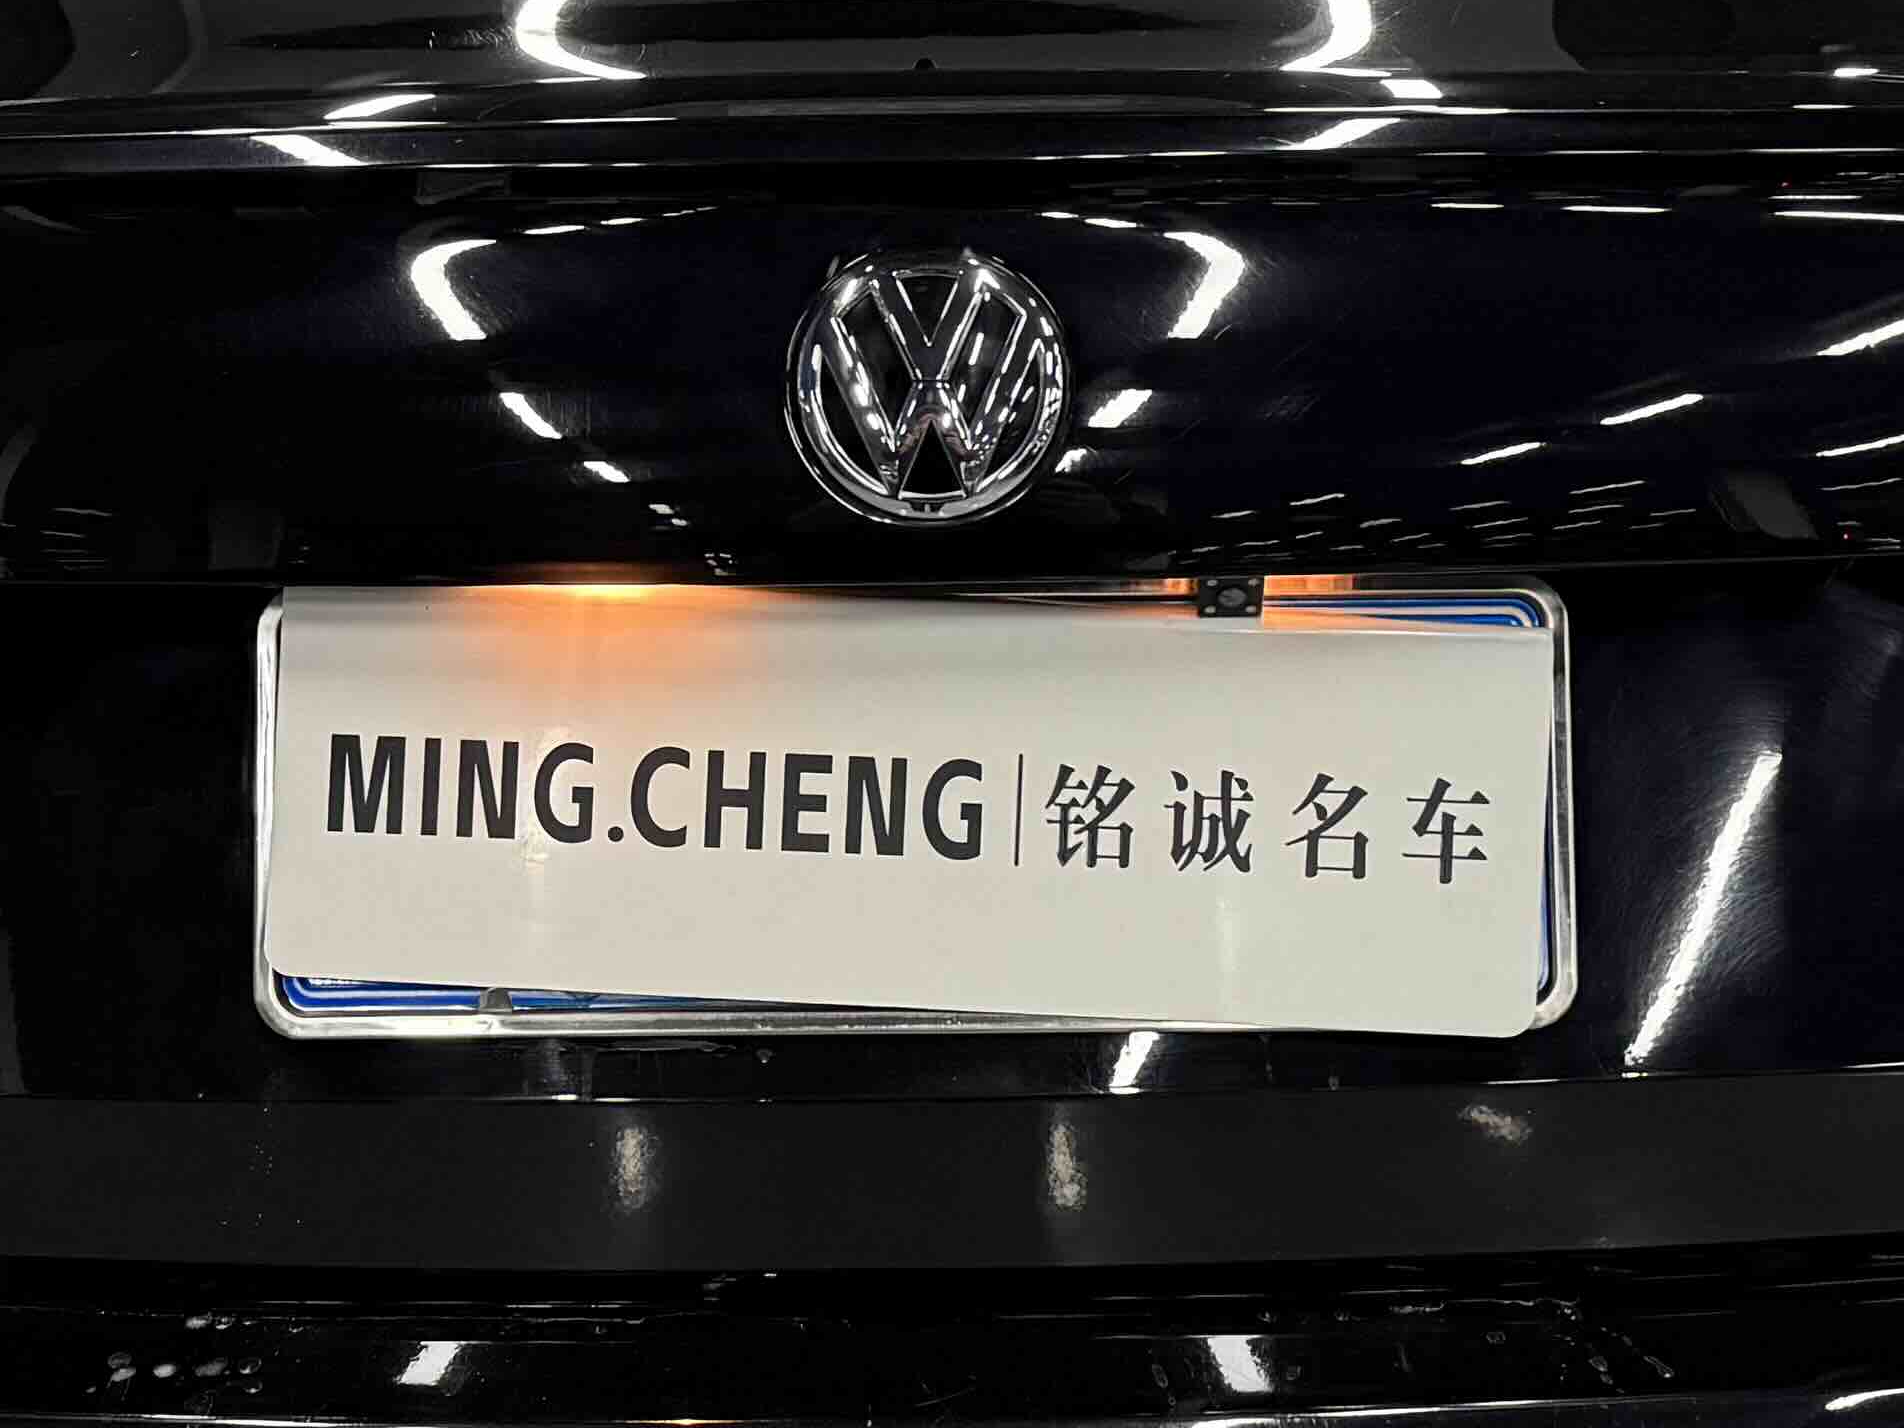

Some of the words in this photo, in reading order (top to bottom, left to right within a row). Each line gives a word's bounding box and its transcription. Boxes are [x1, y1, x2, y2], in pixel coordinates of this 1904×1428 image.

[324, 732, 986, 862] MING.CHENG
[1042, 760, 1493, 887] 铭诚名车
